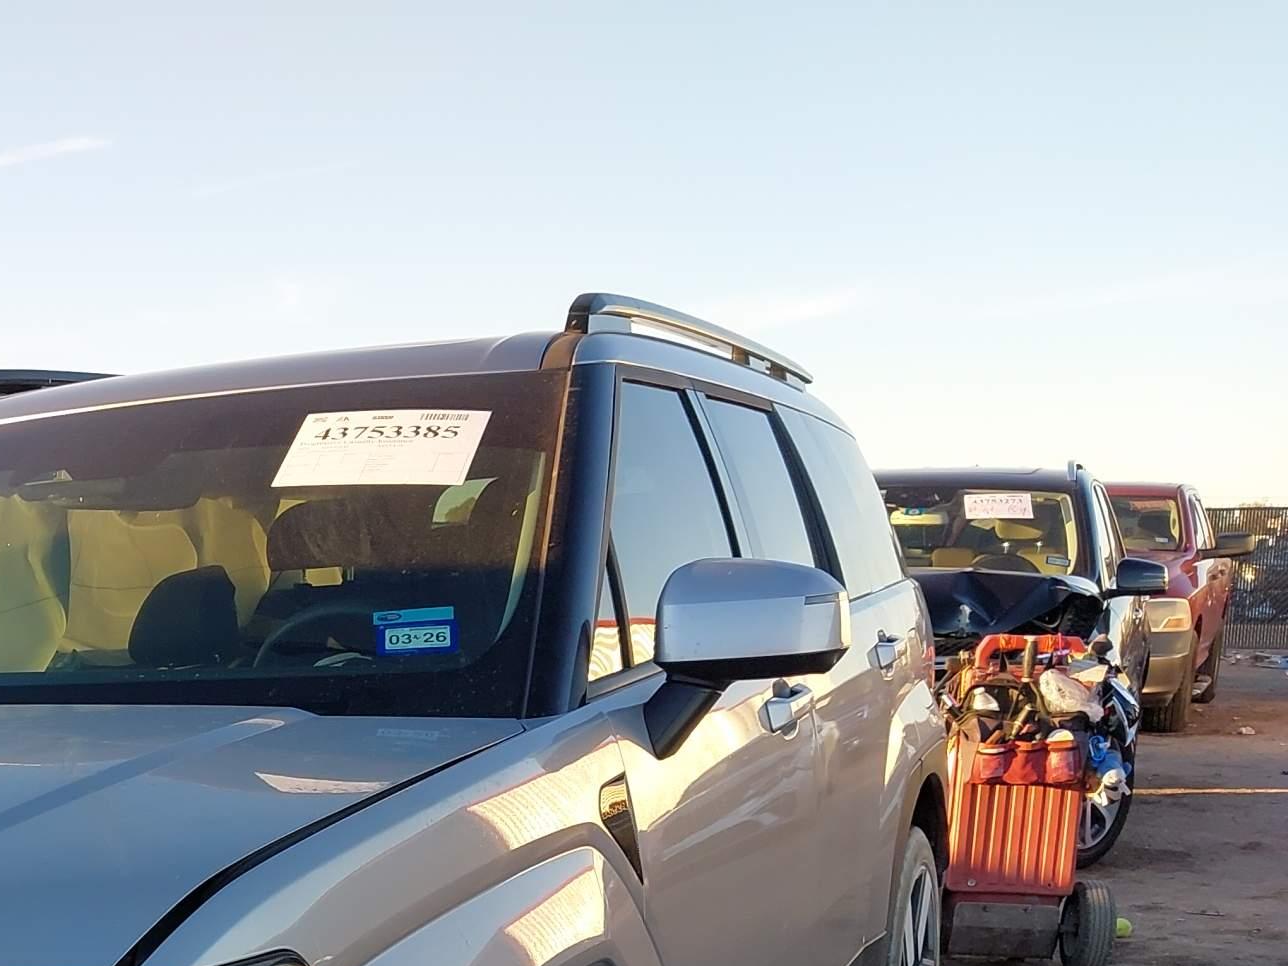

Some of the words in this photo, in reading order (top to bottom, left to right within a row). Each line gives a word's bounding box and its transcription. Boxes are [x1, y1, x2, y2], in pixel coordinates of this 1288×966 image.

[314, 425, 461, 440] 43753385
[389, 633, 412, 645] 03
[423, 631, 447, 643] 26
